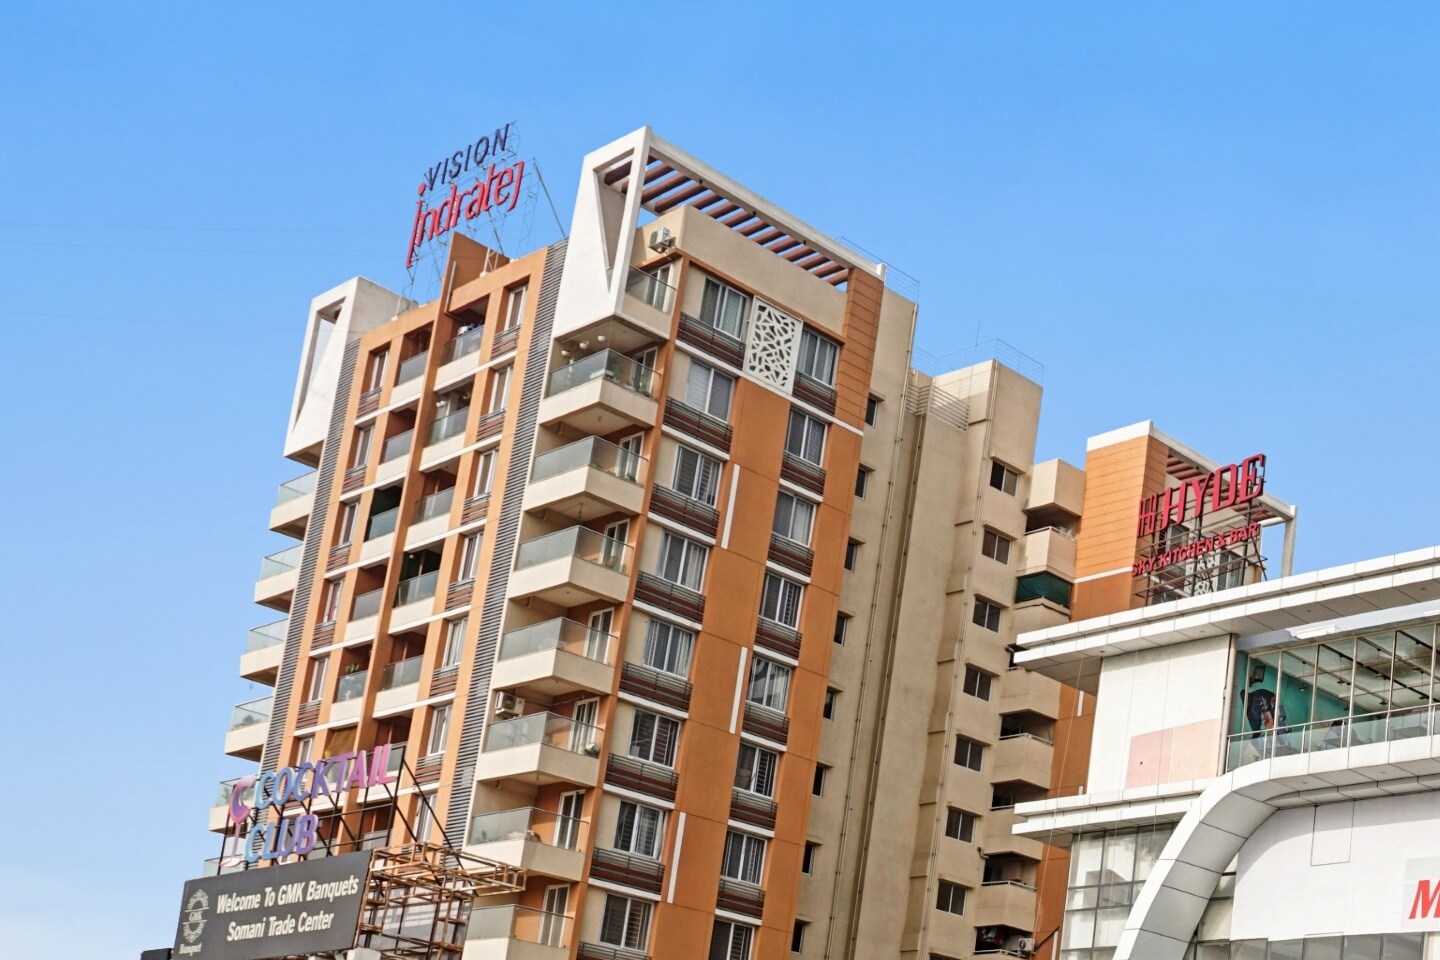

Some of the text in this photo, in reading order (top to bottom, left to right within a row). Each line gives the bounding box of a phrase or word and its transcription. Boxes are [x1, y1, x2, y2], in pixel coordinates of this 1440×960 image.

[423, 123, 511, 192] VISION
[1161, 453, 1266, 531] HYDE
[1131, 522, 1259, 577] SKY KITCHEN & BAR
[254, 743, 397, 810] COCKTAIL
[244, 814, 319, 863] CLUB
[217, 875, 360, 914] Welcome To GMK Banquets
[226, 910, 335, 942] Somani Trade Center
